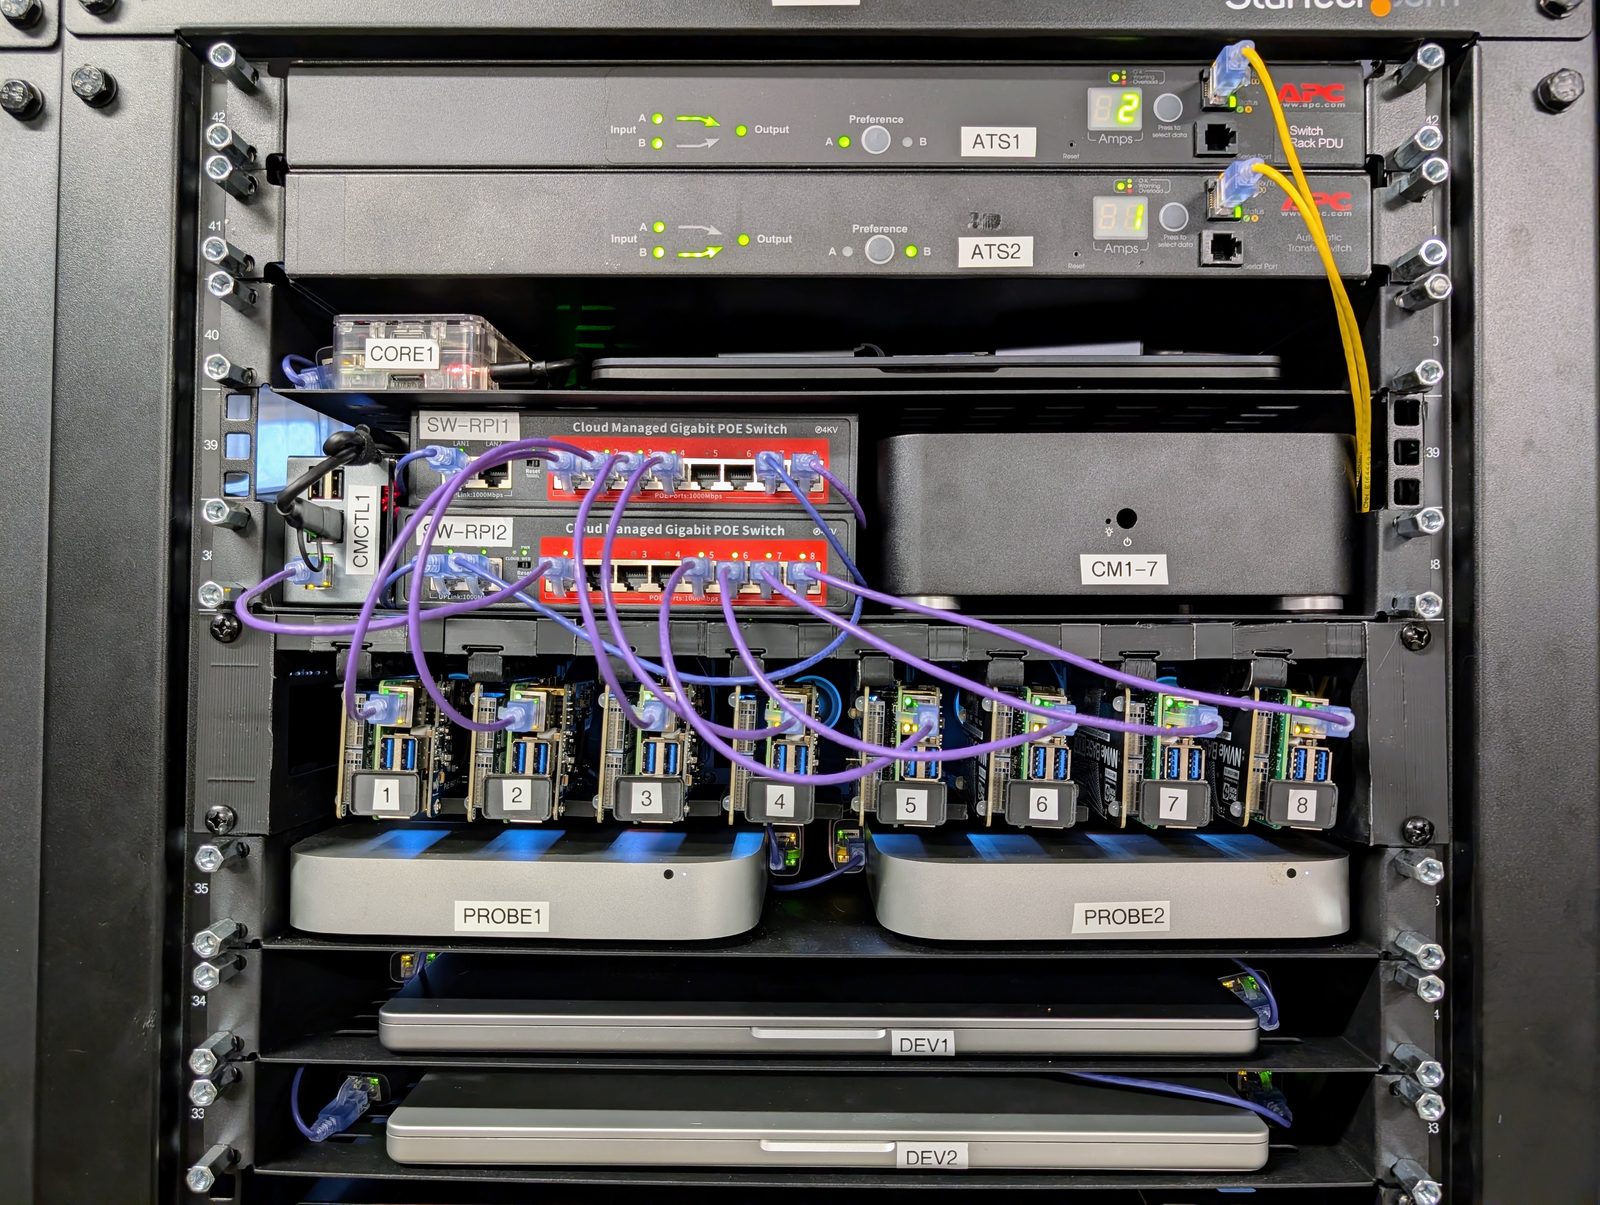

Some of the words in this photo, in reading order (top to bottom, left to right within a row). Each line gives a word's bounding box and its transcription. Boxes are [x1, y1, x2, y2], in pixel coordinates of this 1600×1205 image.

[1278, 83, 1345, 103] APC
[1118, 93, 1140, 123] 2
[211, 112, 226, 123] 42
[638, 114, 647, 122] A
[849, 115, 904, 124] Preference
[1425, 116, 1439, 126] 42
[610, 125, 637, 136] Input
[754, 125, 790, 136] Output
[1289, 125, 1324, 136] Switch
[638, 139, 646, 147] B
[825, 137, 833, 146] A
[919, 137, 927, 146] B
[972, 133, 1021, 150] ATS1
[1099, 134, 1133, 145] Amps
[1318, 138, 1344, 149] PDU
[208, 221, 222, 231] 41
[639, 223, 648, 231] A
[852, 225, 908, 233] Preference
[611, 234, 638, 245] Input
[757, 234, 792, 245] Output
[639, 249, 647, 257] B
[828, 248, 837, 256] A
[923, 248, 931, 256] B
[971, 243, 1021, 260] ATS2
[1104, 243, 1139, 254] Amps
[204, 330, 219, 340] 40
[370, 345, 434, 362] CORE1
[427, 417, 510, 434] SW-RPI1
[573, 422, 609, 434] Cloud
[612, 422, 668, 436] Managed
[670, 422, 716, 436] Gigabit
[718, 423, 743, 434] POE
[745, 423, 788, 435] Switch
[203, 439, 218, 450] 39
[680, 449, 686, 458] 4
[713, 449, 718, 458] 5
[746, 449, 752, 458] 6
[1426, 447, 1440, 458] 39
[352, 495, 370, 568] CMCTL1
[665, 524, 712, 538] Gigabit
[713, 525, 740, 536] POE
[742, 525, 785, 536] Switch
[641, 551, 647, 559] 3
[675, 551, 681, 559] 4
[709, 551, 715, 559] 5
[743, 551, 749, 560] 6
[777, 552, 783, 560] 7
[810, 552, 816, 560] 8
[1091, 561, 1158, 577] CM1-7
[383, 787, 391, 803] 1
[511, 787, 523, 804] 2
[641, 790, 652, 807] 3
[774, 793, 786, 810] 4
[905, 796, 917, 813] 5
[1036, 796, 1048, 813] 6
[1168, 796, 1179, 813] 7
[1297, 796, 1308, 814] 8
[194, 882, 209, 894] 35
[464, 907, 541, 925] PROBE1
[1084, 907, 1165, 926] PROBE2
[192, 995, 206, 1007] 34
[900, 1037, 948, 1053] DEV1
[191, 1108, 205, 1119] 33
[906, 1150, 958, 1166] DEV2
